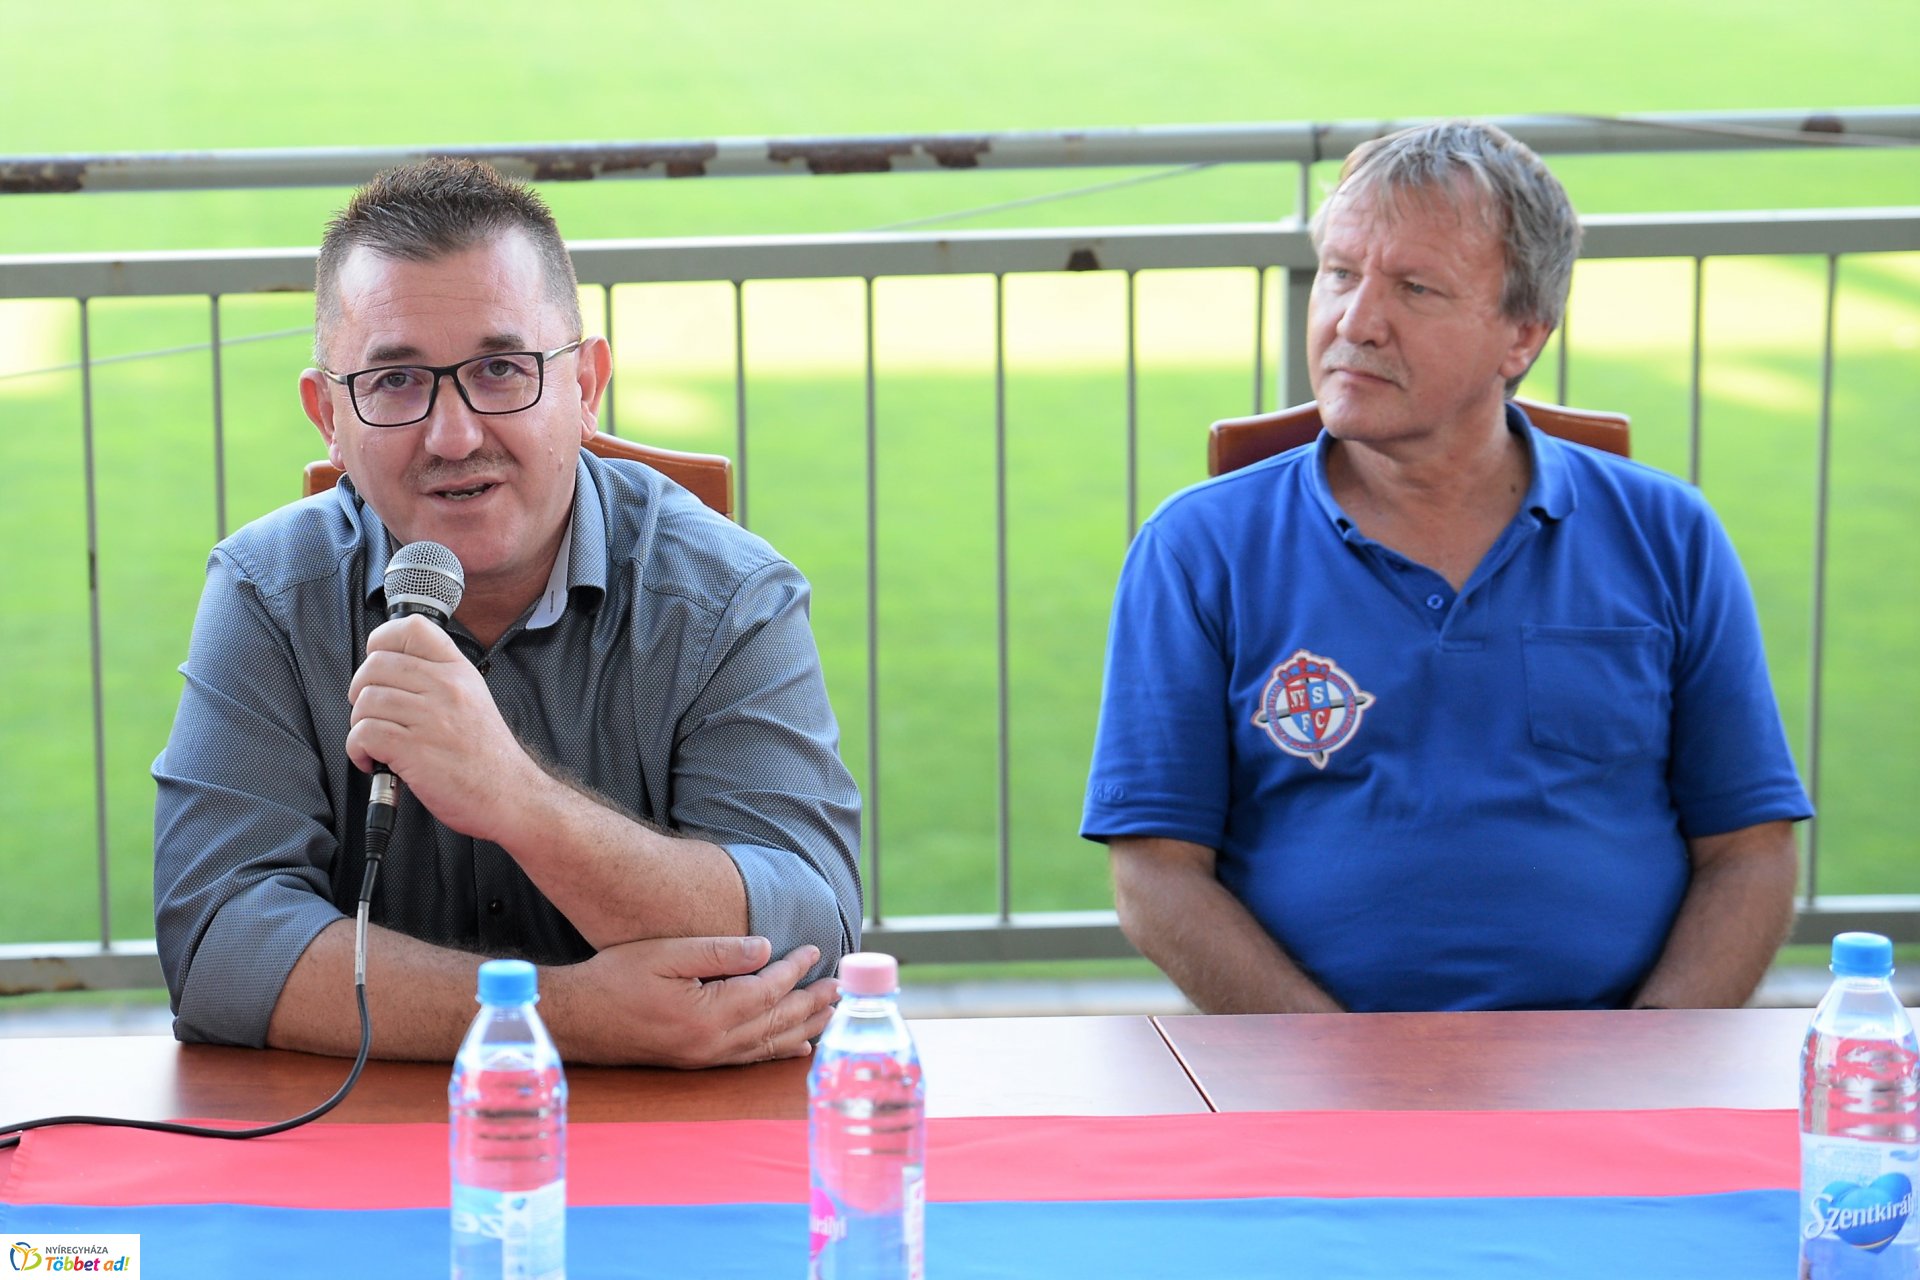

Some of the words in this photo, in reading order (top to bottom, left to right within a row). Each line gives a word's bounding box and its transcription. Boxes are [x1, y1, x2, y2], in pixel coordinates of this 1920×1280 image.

[1289, 688, 1306, 709] NY
[1311, 686, 1325, 704] S
[1301, 713, 1311, 732] F
[1314, 711, 1326, 729] C
